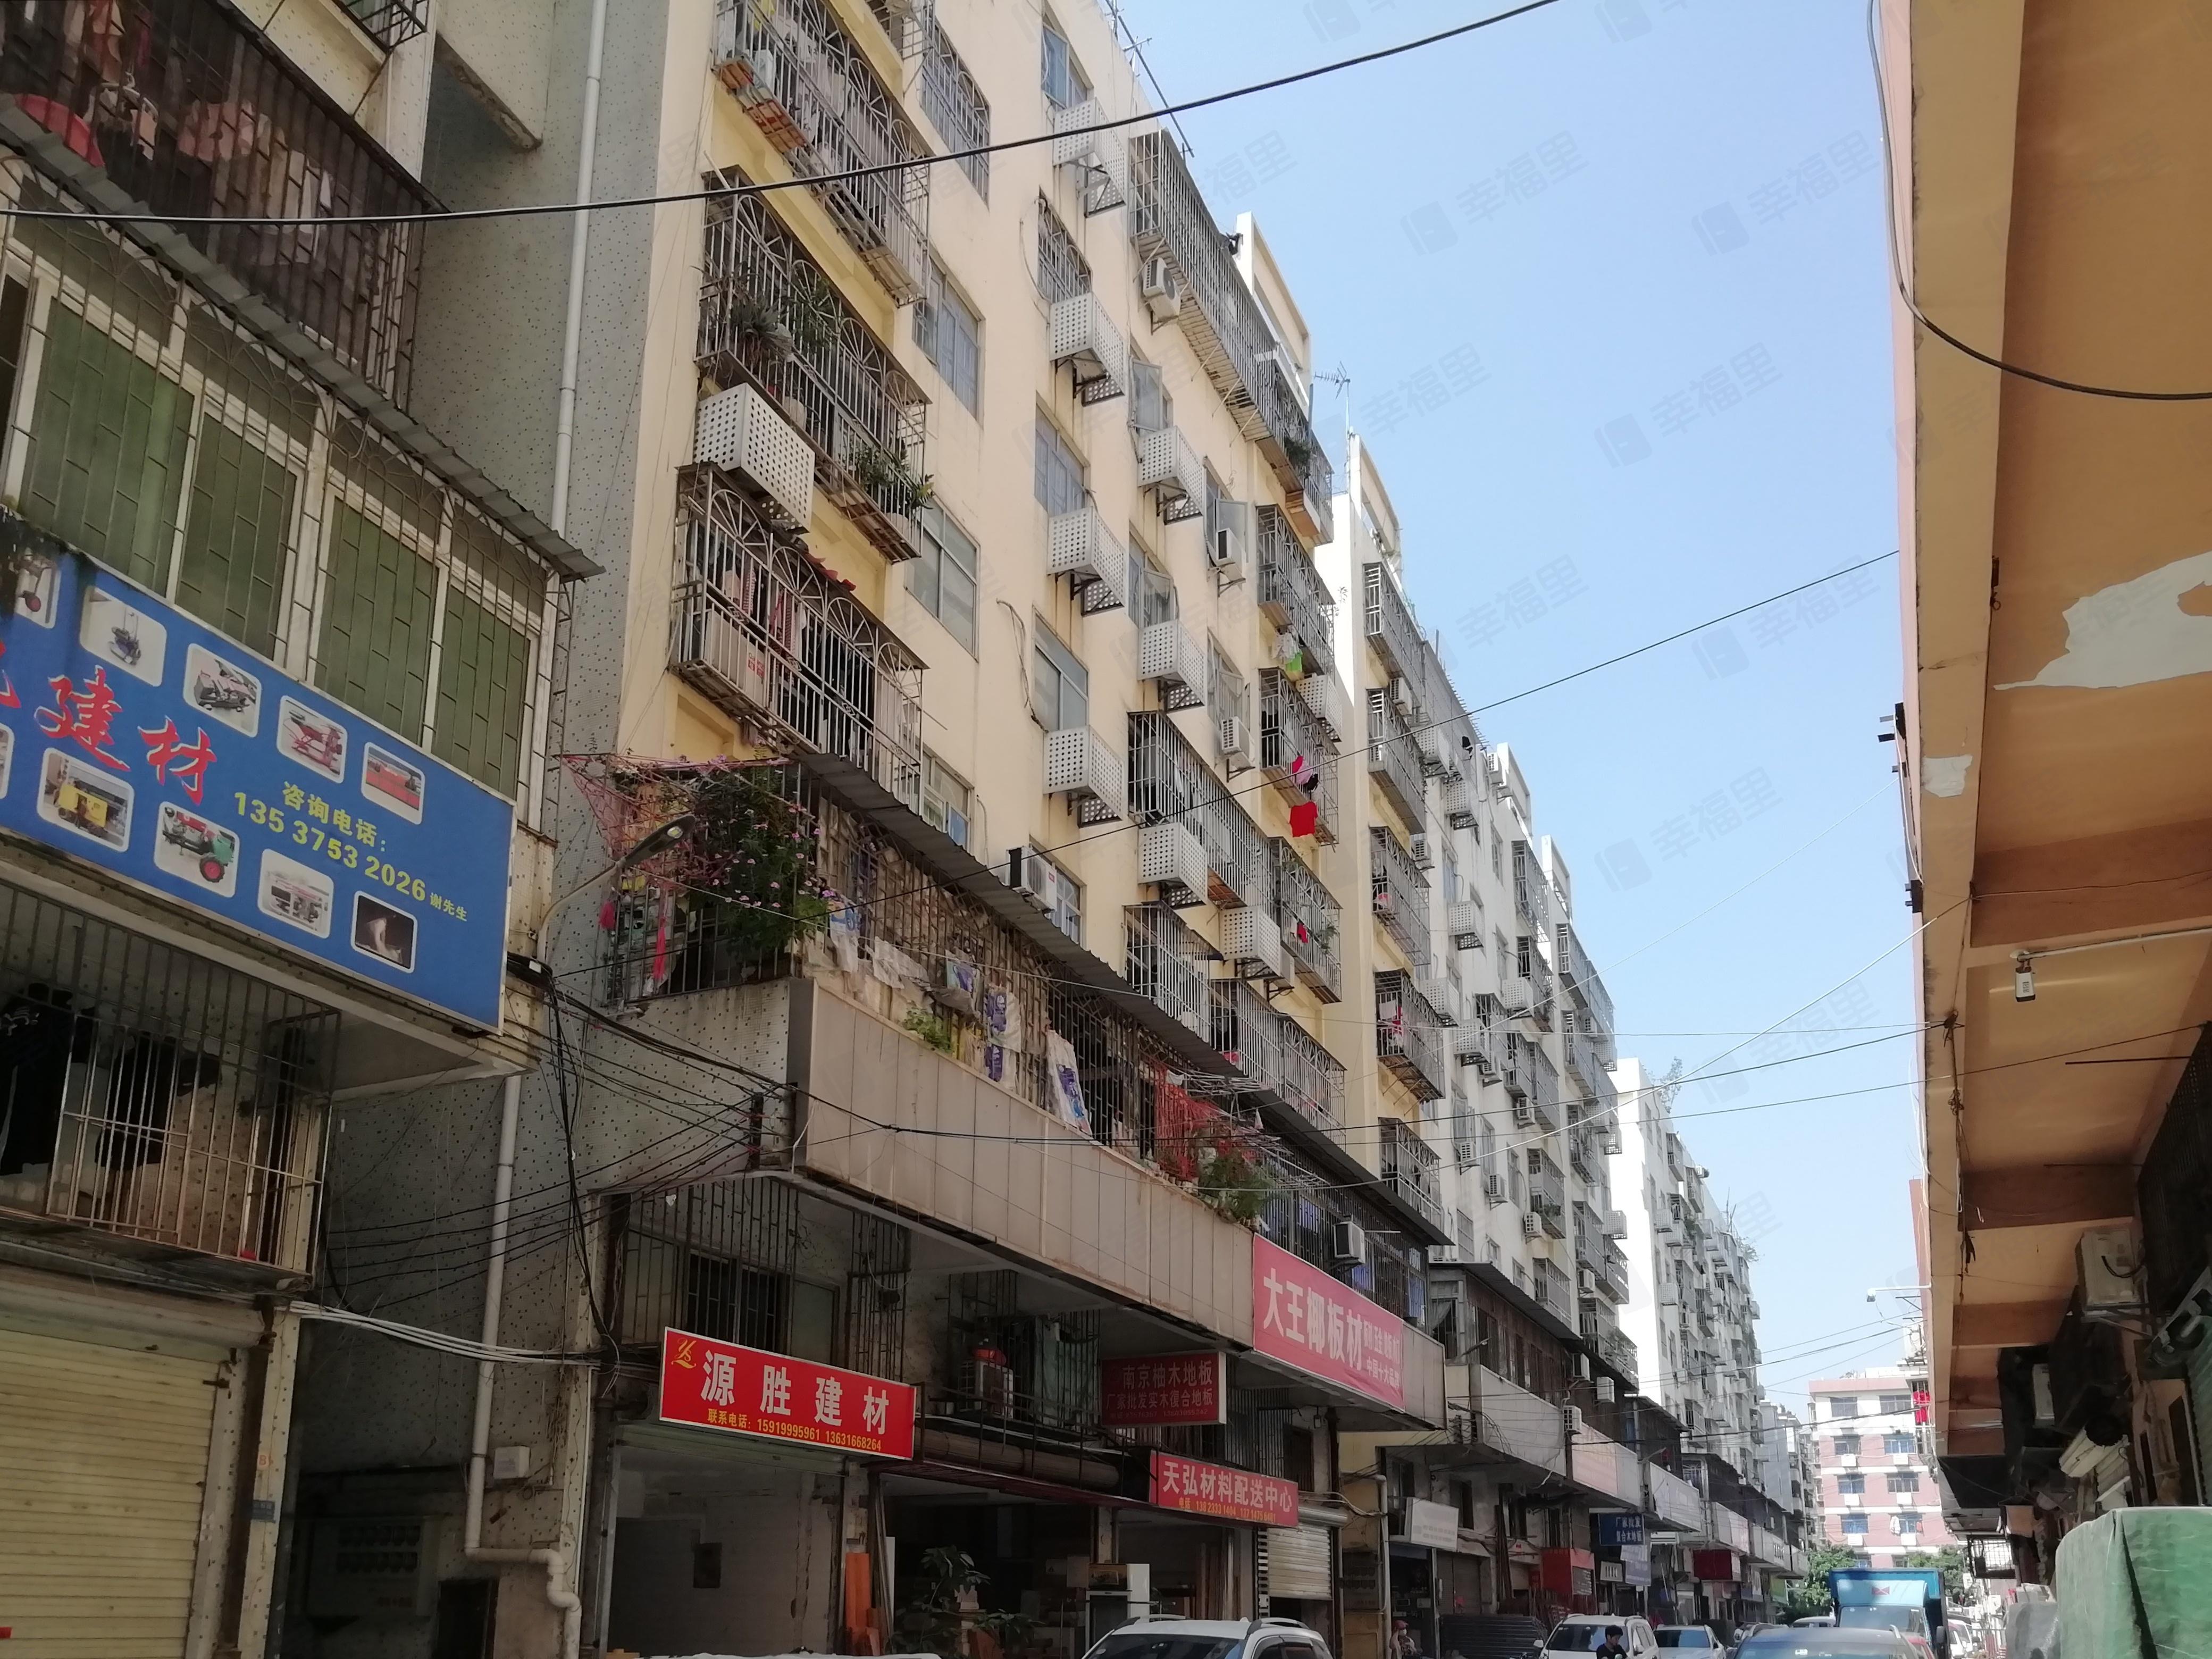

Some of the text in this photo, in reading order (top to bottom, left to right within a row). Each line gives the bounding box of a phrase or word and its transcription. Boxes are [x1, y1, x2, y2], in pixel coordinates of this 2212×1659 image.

[0, 642, 217, 805] 建材
[235, 792, 467, 922] 135 3753 2026 谢先生
[700, 1350, 889, 1435] 源胜建材
[1121, 1360, 1213, 1390] 南京柚木地板
[757, 1419, 820, 1441] 15919995961
[825, 1430, 882, 1452] 13631668264
[1163, 1461, 1293, 1512] 天弘材料配送中心
[1196, 1500, 1206, 1511] 138
